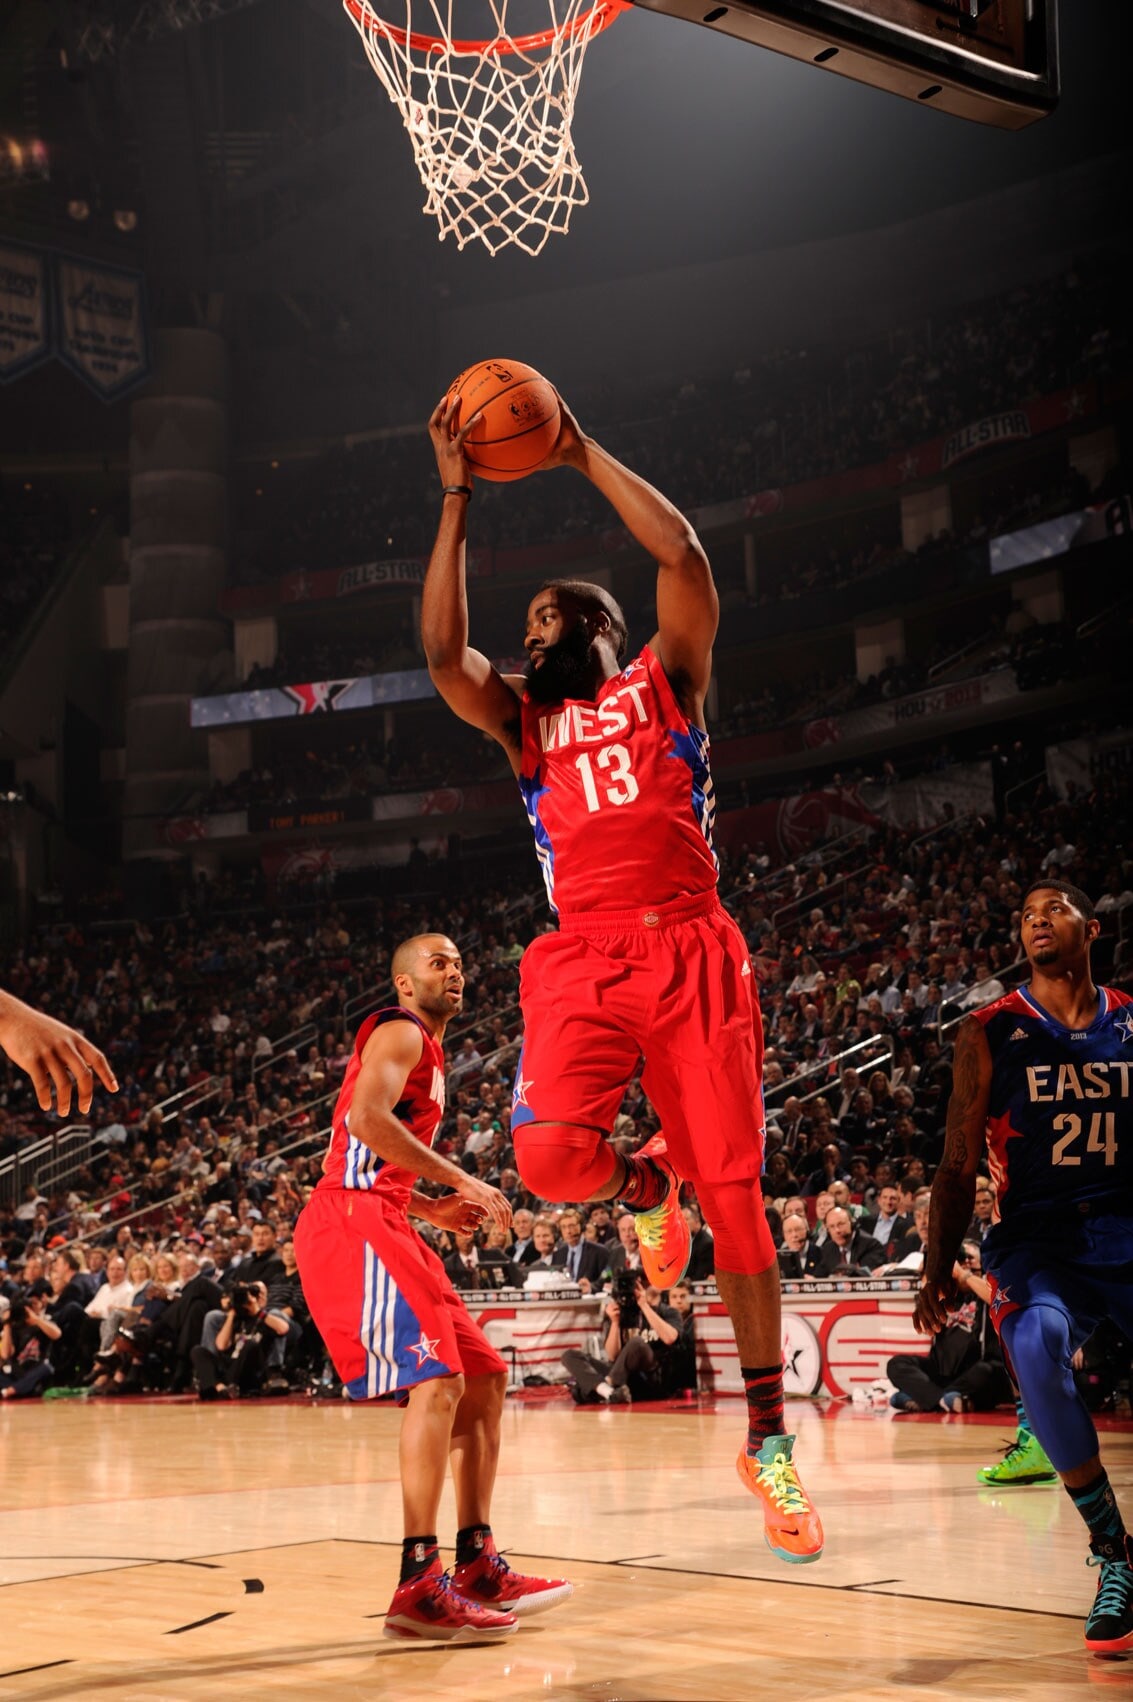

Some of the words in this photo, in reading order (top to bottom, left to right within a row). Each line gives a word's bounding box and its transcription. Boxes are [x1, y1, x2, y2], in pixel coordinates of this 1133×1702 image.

[944, 413, 1028, 465] ALL-STAR
[340, 561, 424, 592] ALL-STAR
[538, 680, 649, 753] WEST
[575, 743, 640, 813] 13
[1070, 1032, 1088, 1041] 2013
[1026, 1062, 1133, 1102] EAST
[1052, 1112, 1118, 1166] 24
